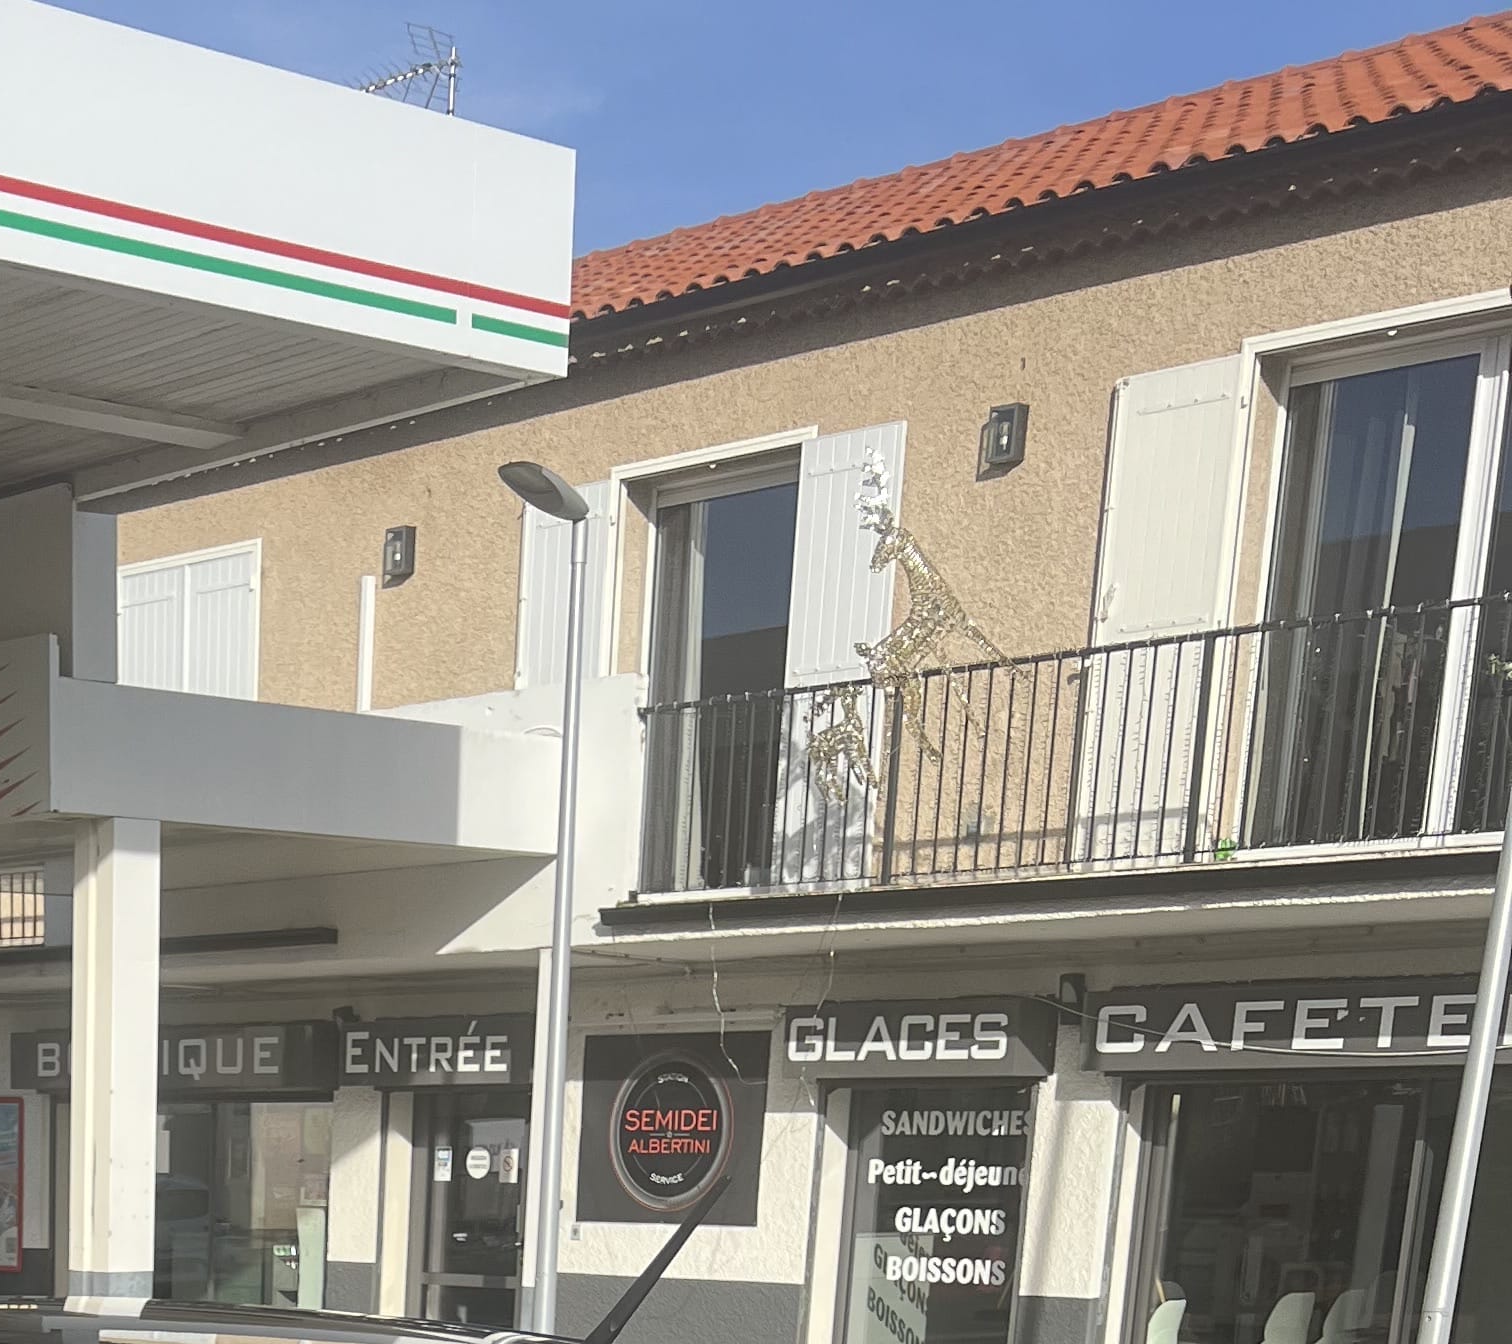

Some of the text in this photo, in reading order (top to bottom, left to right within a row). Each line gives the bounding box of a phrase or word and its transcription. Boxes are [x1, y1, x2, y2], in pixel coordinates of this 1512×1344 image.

[346, 1020, 509, 1075] ENTRÉE
[787, 1013, 1008, 1062] GLACES
[624, 1109, 718, 1131] SEMIDEI
[628, 1138, 710, 1154] ALBERTINI
[649, 1172, 685, 1184] SERVICE
[895, 1207, 1006, 1242] GLAÇONS
[886, 1255, 1006, 1286] BOISSONS
